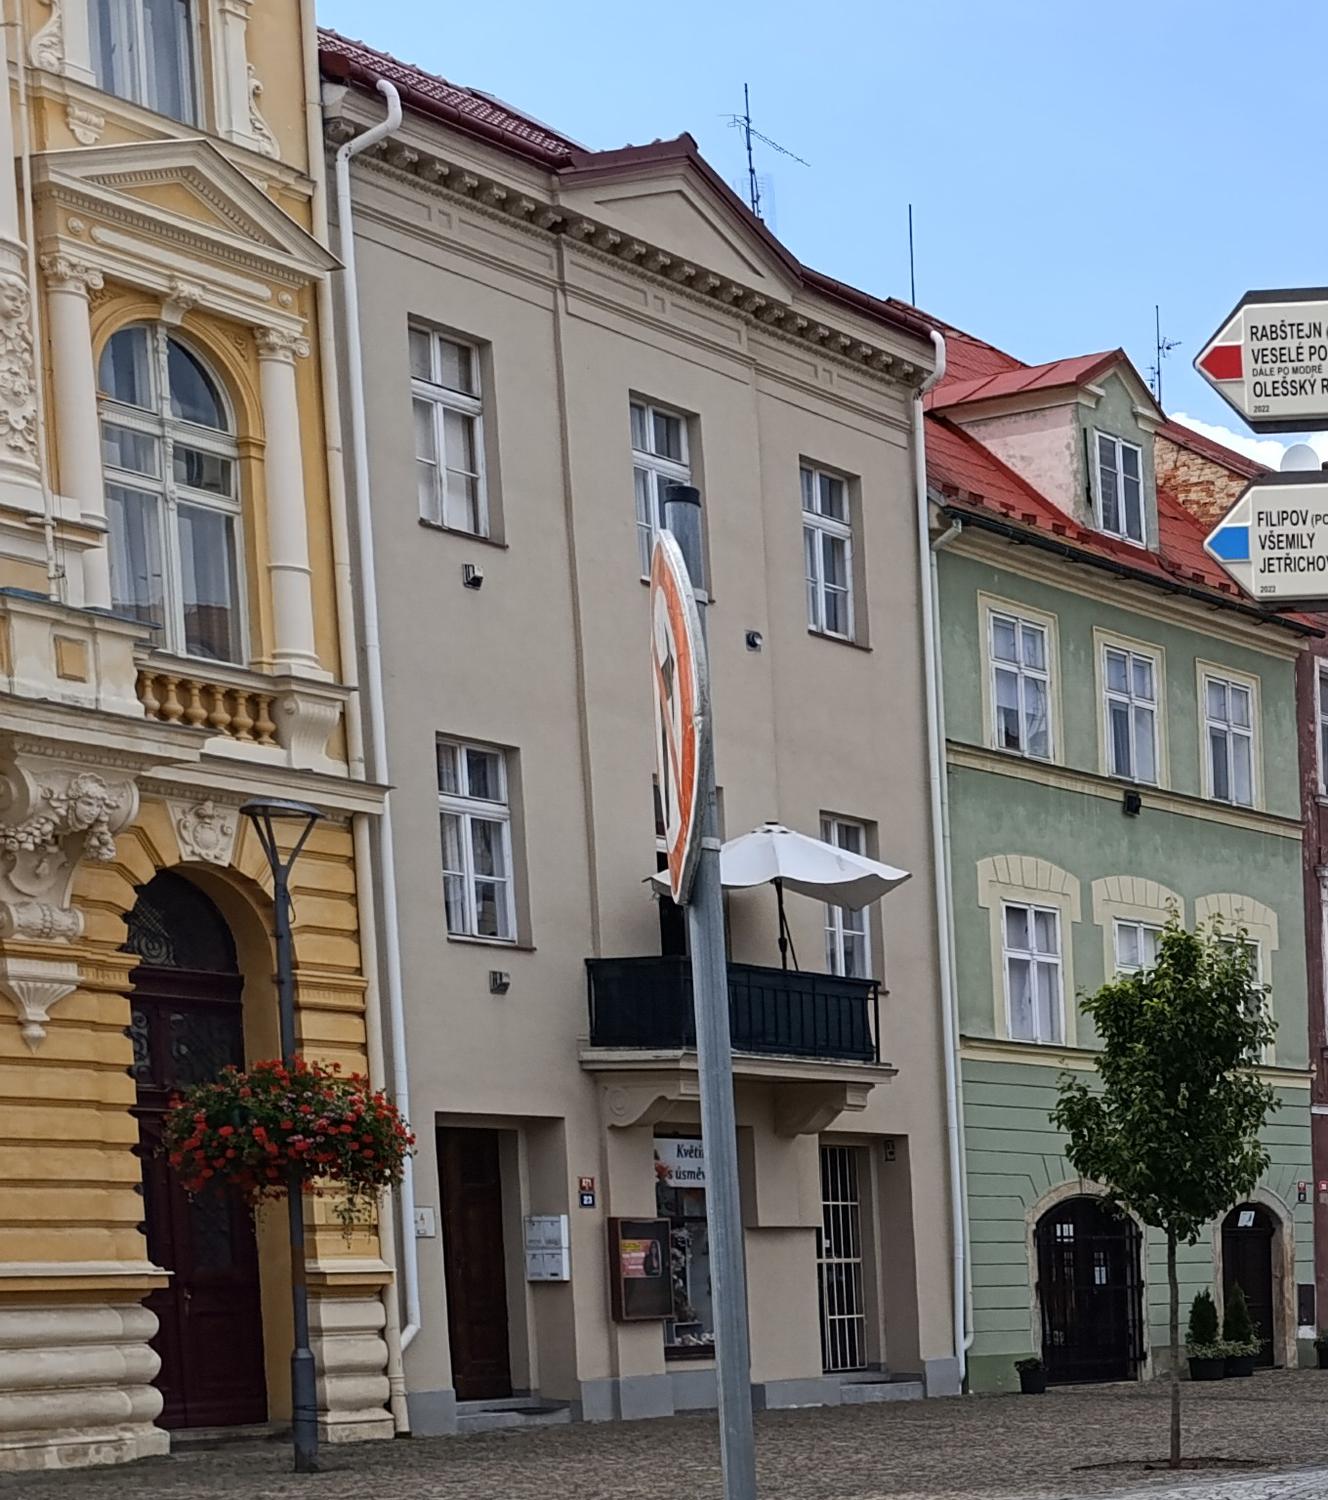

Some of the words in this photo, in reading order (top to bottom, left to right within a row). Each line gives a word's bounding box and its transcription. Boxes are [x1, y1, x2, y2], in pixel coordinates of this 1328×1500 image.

[1250, 320, 1322, 342] RABŠTEJN
[1252, 342, 1304, 365] VESELÉ
[1277, 366, 1289, 376] PO
[1291, 364, 1323, 375] MODRÉ
[1253, 374, 1316, 398] OLEŠSKÝ
[1257, 509, 1309, 528] FILIPOV
[1259, 530, 1315, 550] VŠEMILY
